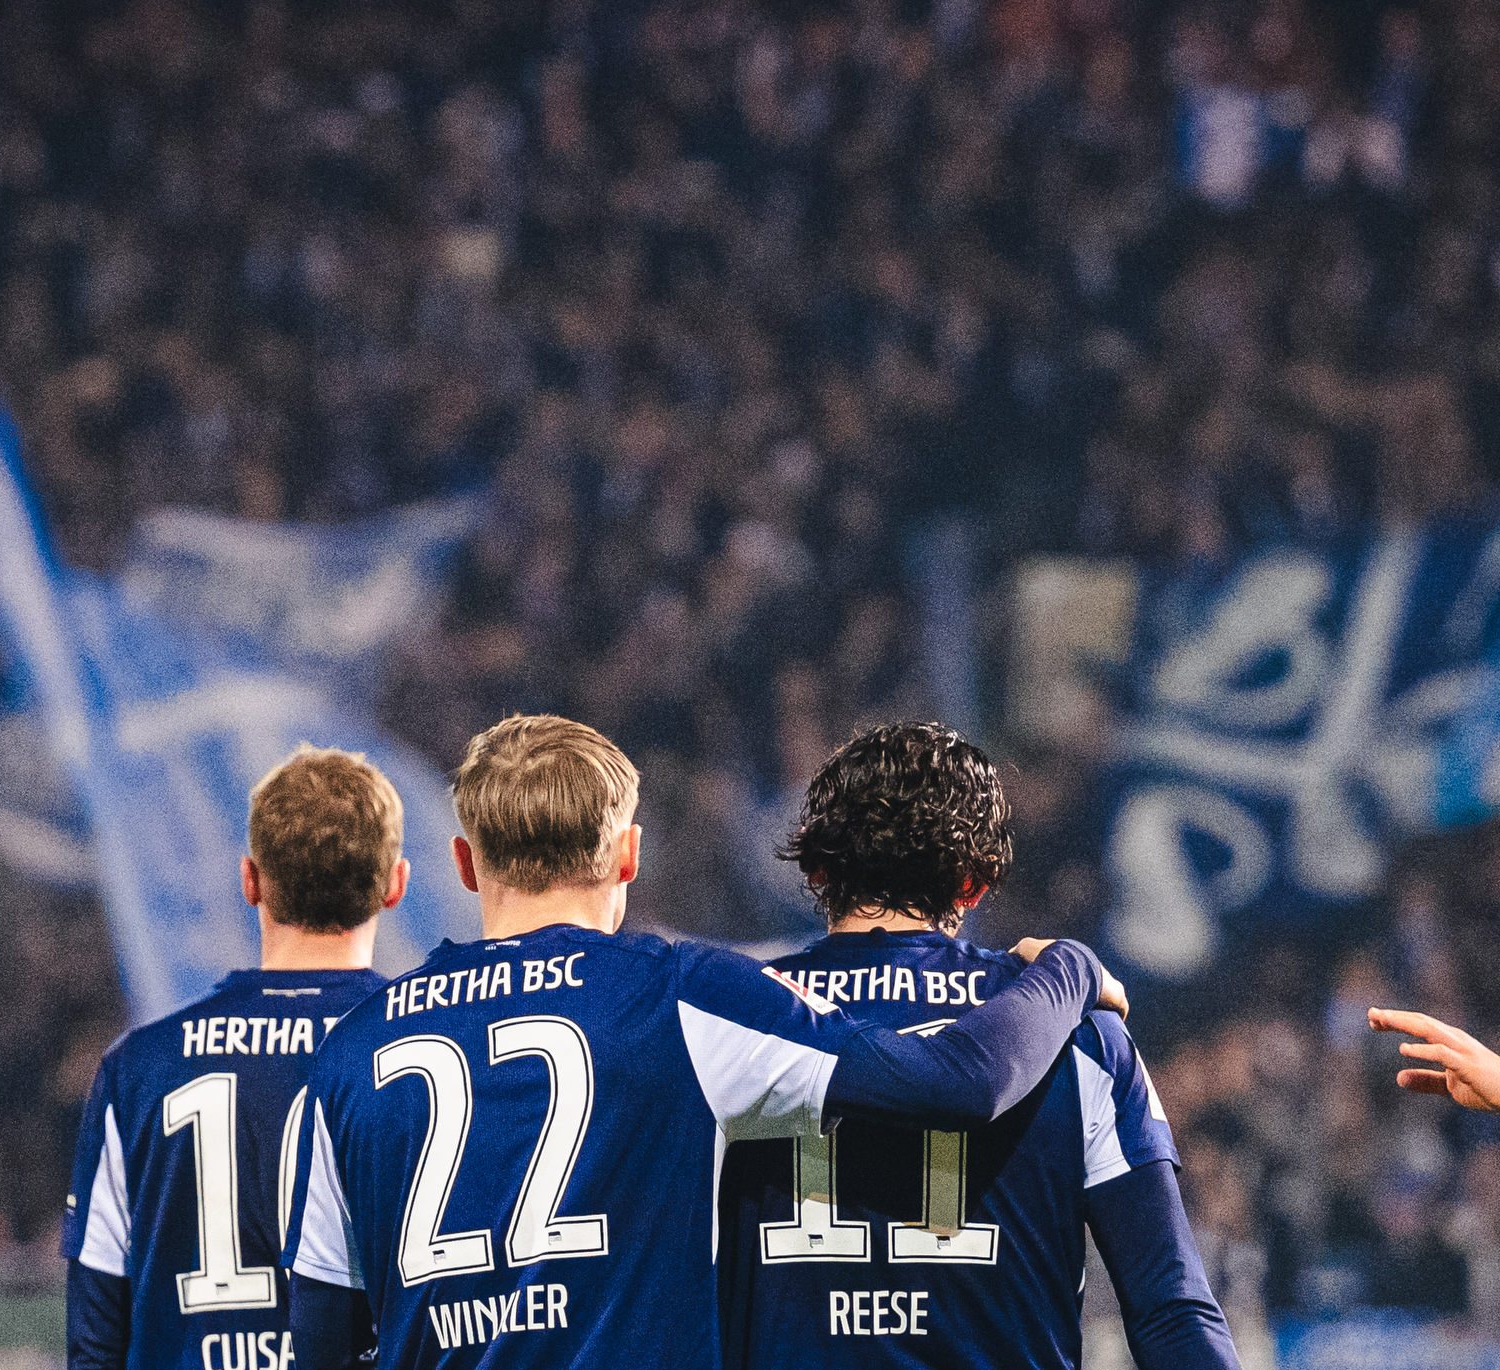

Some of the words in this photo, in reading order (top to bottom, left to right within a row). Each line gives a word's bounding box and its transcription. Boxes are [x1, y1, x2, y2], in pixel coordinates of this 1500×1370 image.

[385, 962, 512, 1021] HERTHA
[522, 952, 585, 993] BSC
[923, 970, 986, 1006] BSC
[183, 1016, 314, 1057] HERTHA
[373, 1014, 608, 1288] 22
[163, 1072, 308, 1315] 1
[428, 1283, 569, 1350] WINKLER
[830, 1290, 928, 1336] REESE
